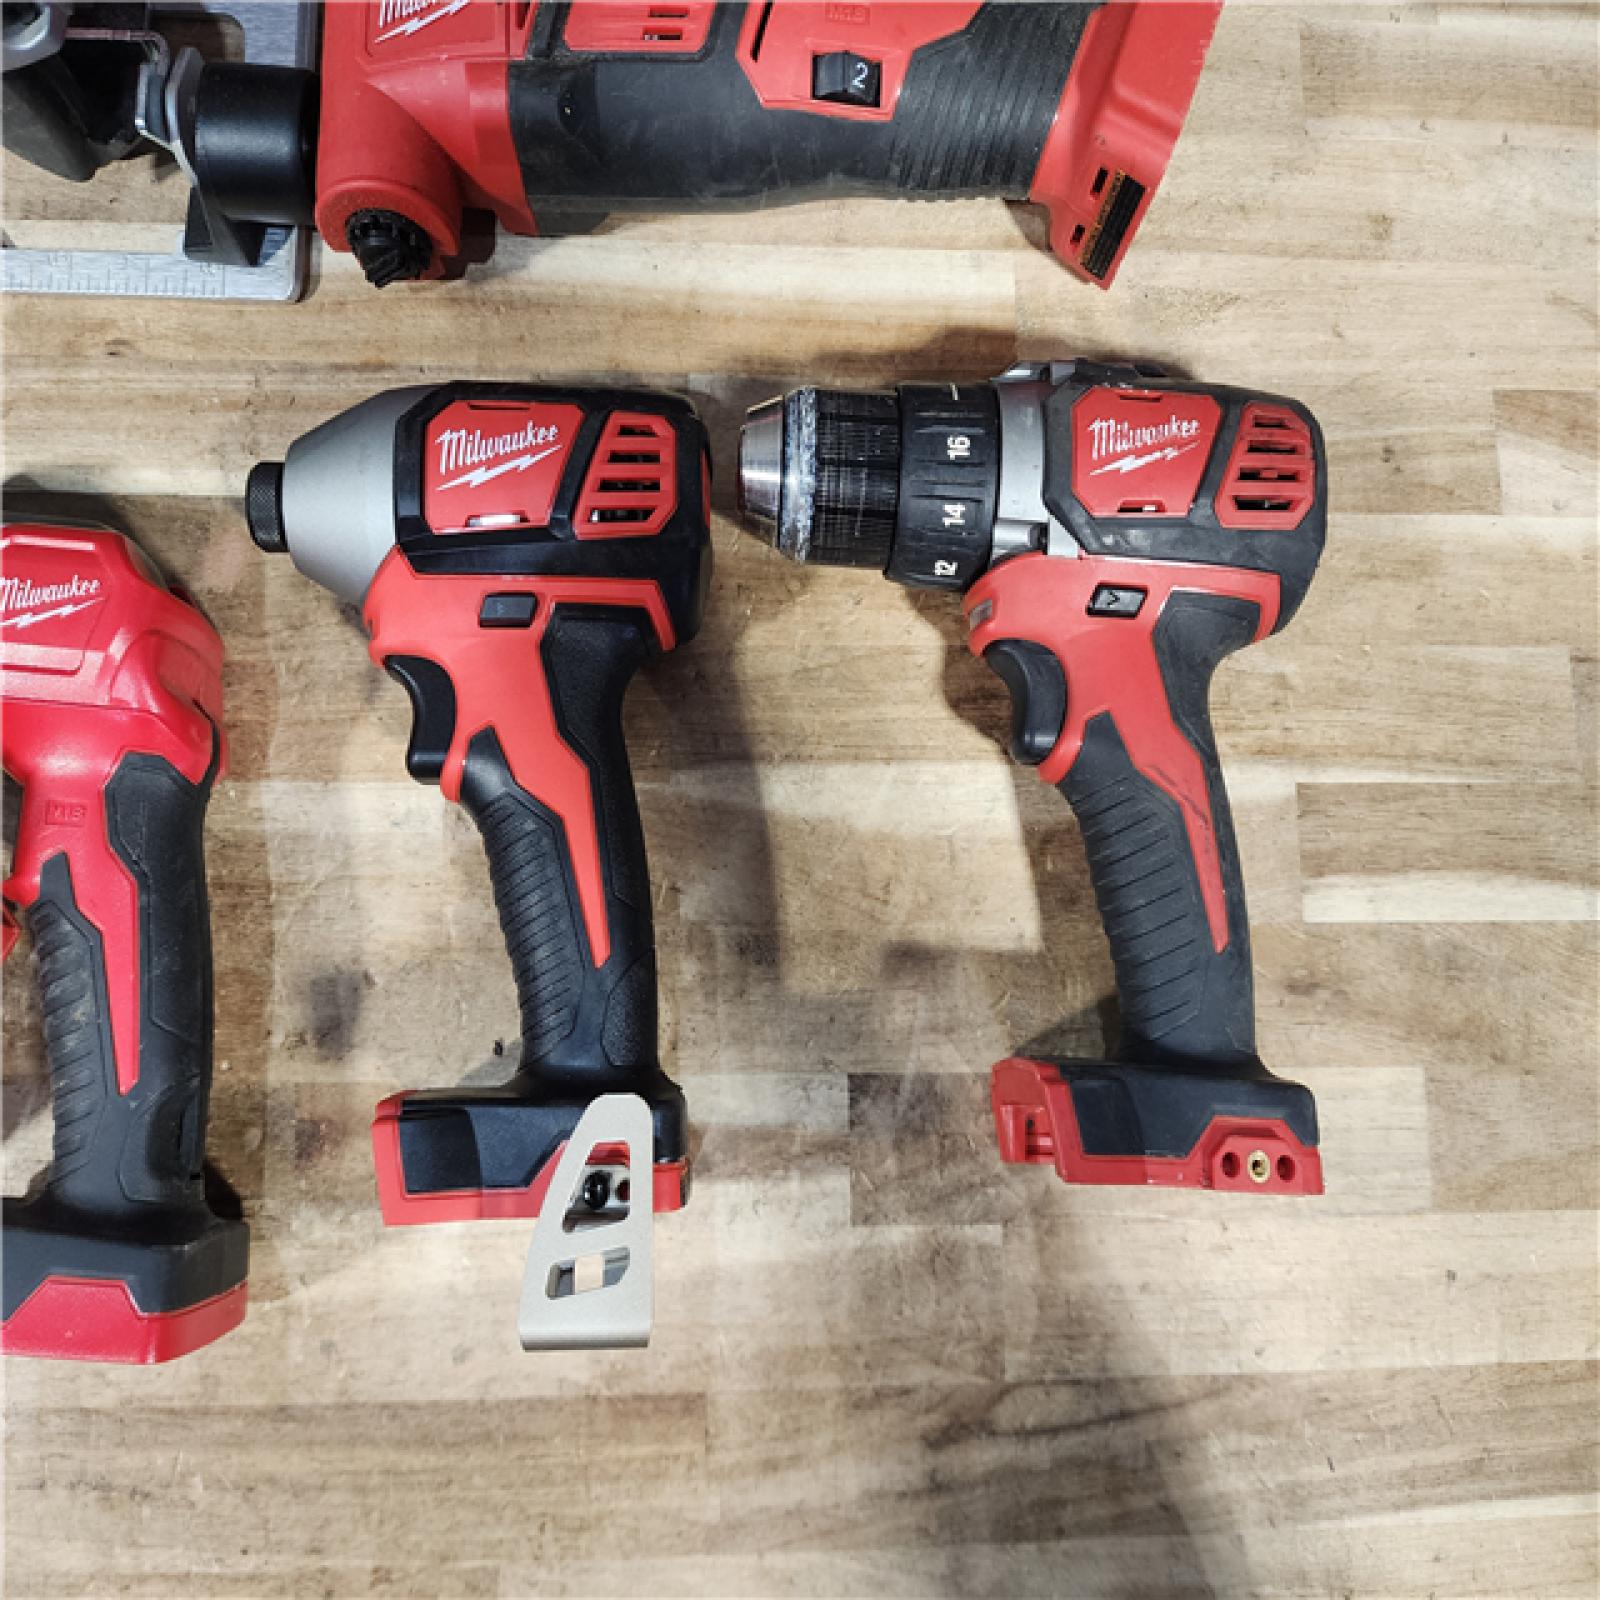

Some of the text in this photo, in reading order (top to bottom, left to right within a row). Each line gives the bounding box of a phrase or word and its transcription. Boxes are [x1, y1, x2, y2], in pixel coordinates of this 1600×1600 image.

[852, 62, 868, 88] 2
[435, 420, 559, 475] Milwaukee
[947, 434, 971, 460] 16
[1088, 415, 1200, 460] Milwaukee
[942, 503, 966, 528] 14
[0, 575, 101, 613] Milwaukee
